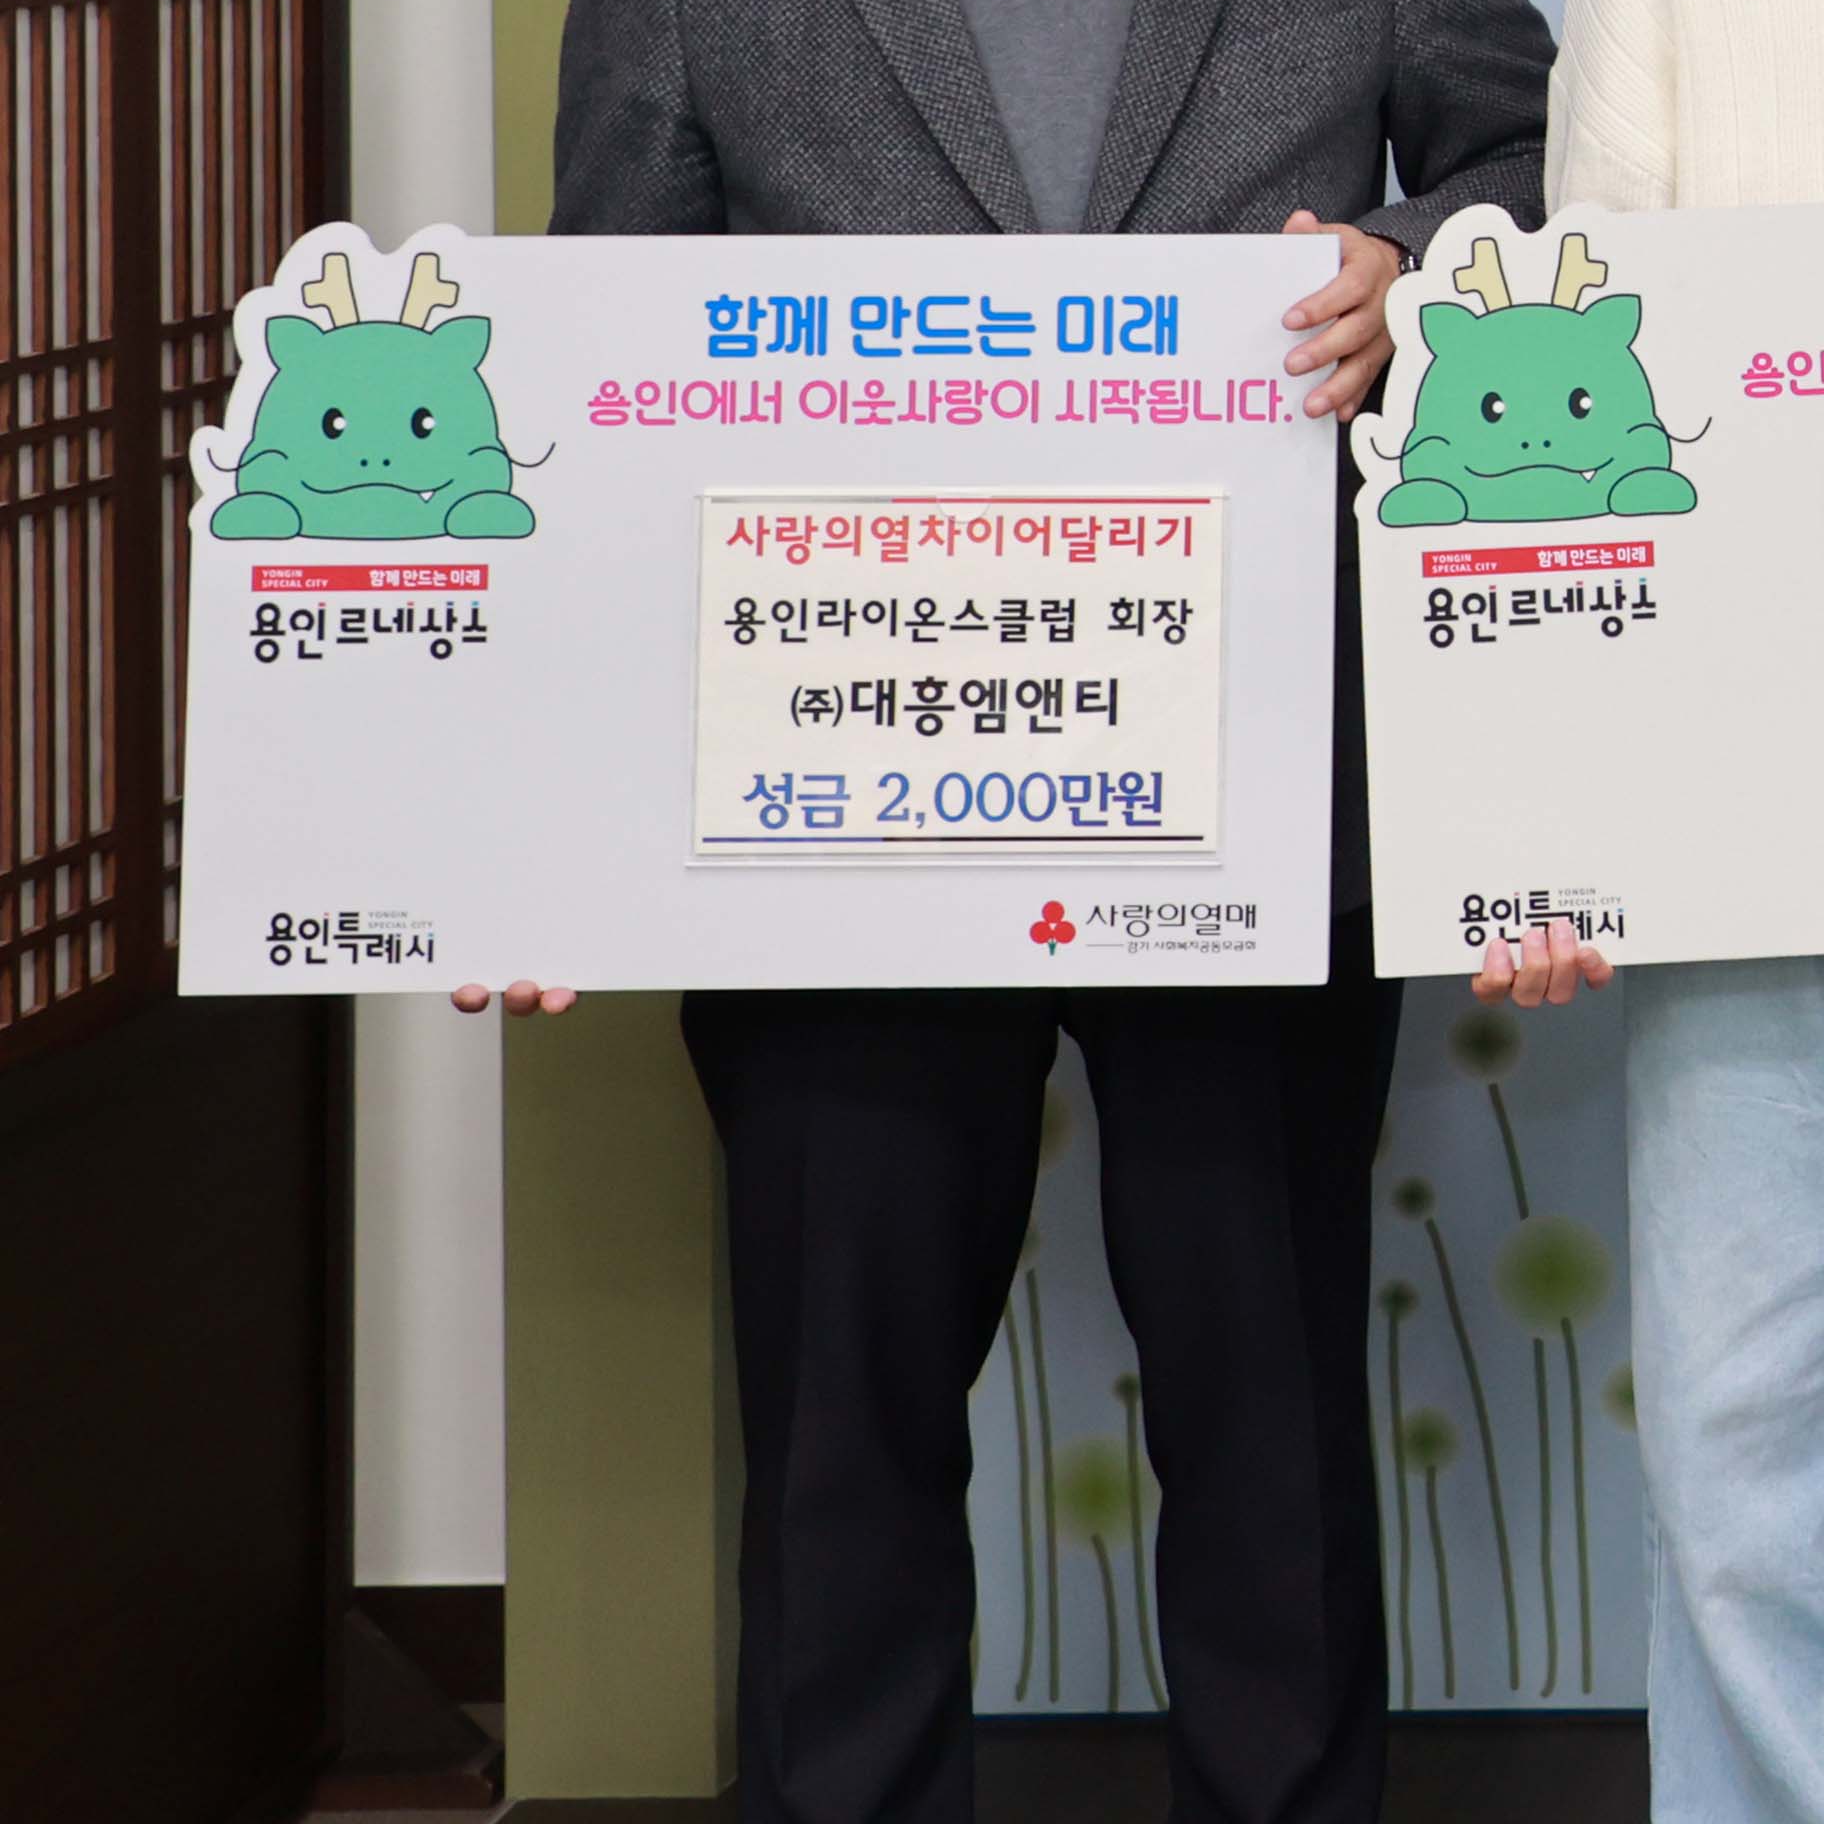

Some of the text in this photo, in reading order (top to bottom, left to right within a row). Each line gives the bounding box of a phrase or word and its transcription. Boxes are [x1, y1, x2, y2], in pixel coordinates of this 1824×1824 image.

[705, 294, 1178, 358] 함께 만드는 미래
[588, 379, 1293, 426] 용인에서 이웃사랑이 시작됩니다.
[727, 515, 1192, 565] 사랑의열차이어달리기
[1433, 554, 1471, 563] YONGIN
[1537, 547, 1645, 567] 함께 만드는 미래
[370, 570, 480, 586] 함께 만드는 미래
[1432, 563, 1496, 573] SPECIAL CITY
[725, 598, 1193, 645] 용인라이온스클럽 회장
[743, 772, 1162, 829] 성금 2,000만원
[266, 912, 434, 966] 용인특례시
[1087, 904, 1256, 937] 사랑의열매
